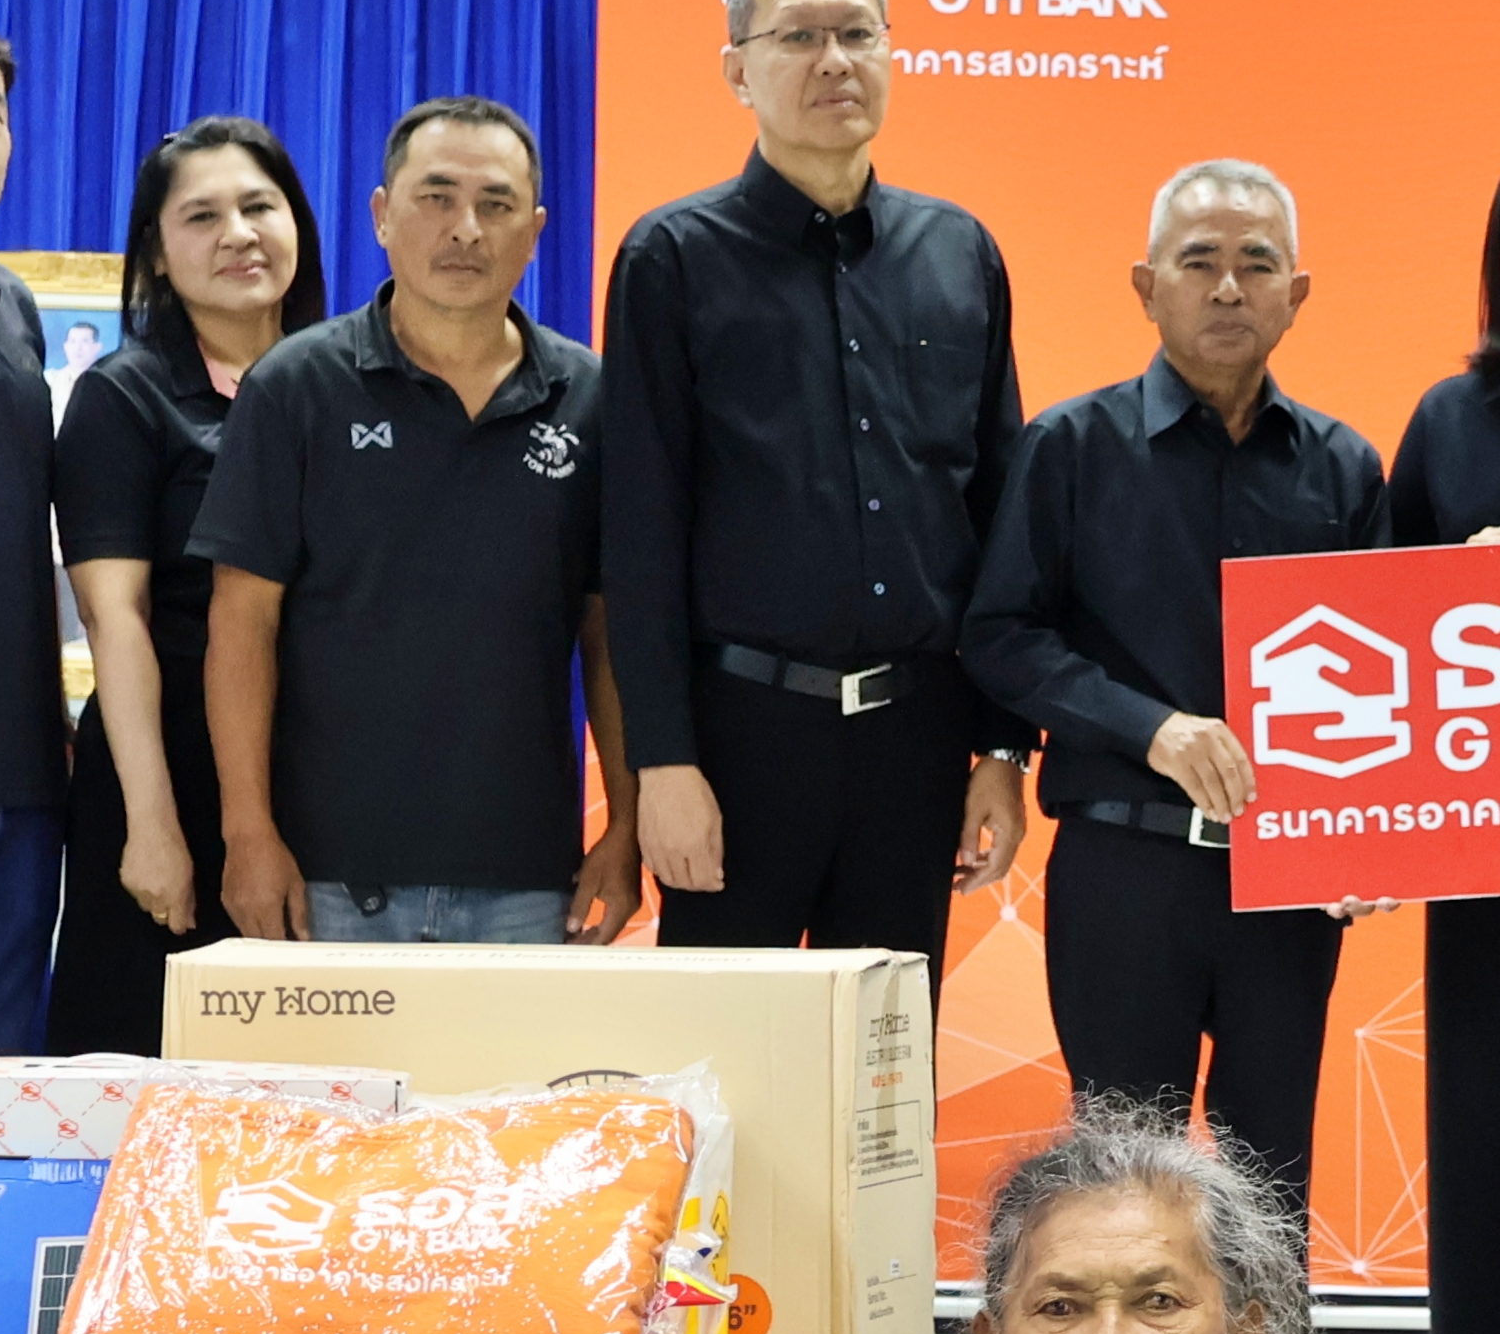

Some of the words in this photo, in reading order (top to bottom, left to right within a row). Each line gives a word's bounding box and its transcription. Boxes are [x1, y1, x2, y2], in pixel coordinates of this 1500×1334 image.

[891, 44, 1169, 80] าคารสงเคราะห์
[1435, 717, 1491, 772] G
[200, 988, 266, 1024] my
[274, 986, 396, 1017] Home
[354, 1182, 527, 1229] ธอส
[425, 1227, 515, 1255] BANK
